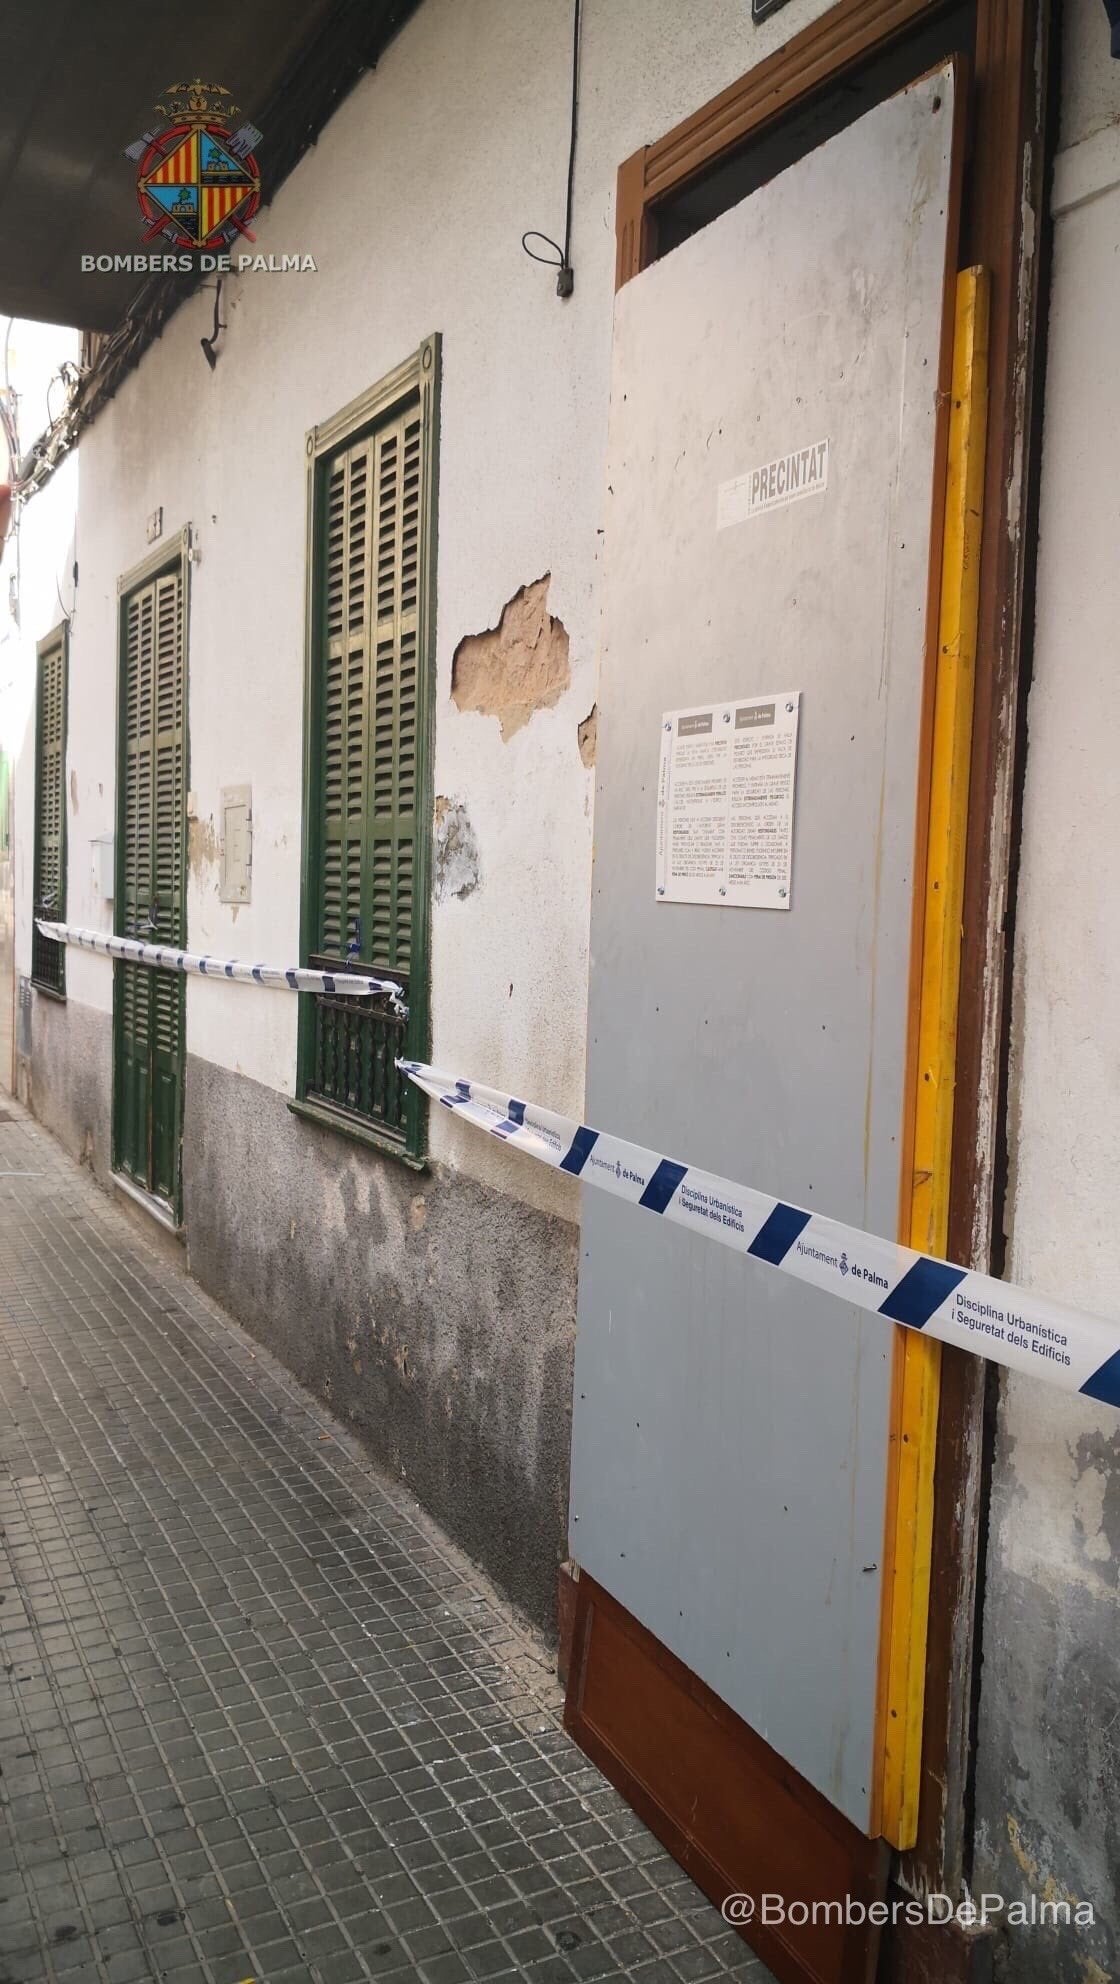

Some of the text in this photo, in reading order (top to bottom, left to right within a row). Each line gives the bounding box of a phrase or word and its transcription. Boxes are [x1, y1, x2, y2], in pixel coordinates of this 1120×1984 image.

[751, 442, 827, 505] PRECINTAT
[590, 1154, 645, 1186] Ajuntament de Palma
[681, 1184, 743, 1218] Disciplina Urbanística
[681, 1197, 709, 1218] Seguretat
[709, 1209, 722, 1224] dels
[722, 1213, 745, 1233] Edificis
[796, 1241, 889, 1289] Ajuntament de Palma
[956, 1293, 1068, 1346] Disciplina Urbanística
[957, 1310, 1005, 1341] Seguretat
[1007, 1331, 1029, 1349] dels
[1031, 1340, 1072, 1366] Edificis
